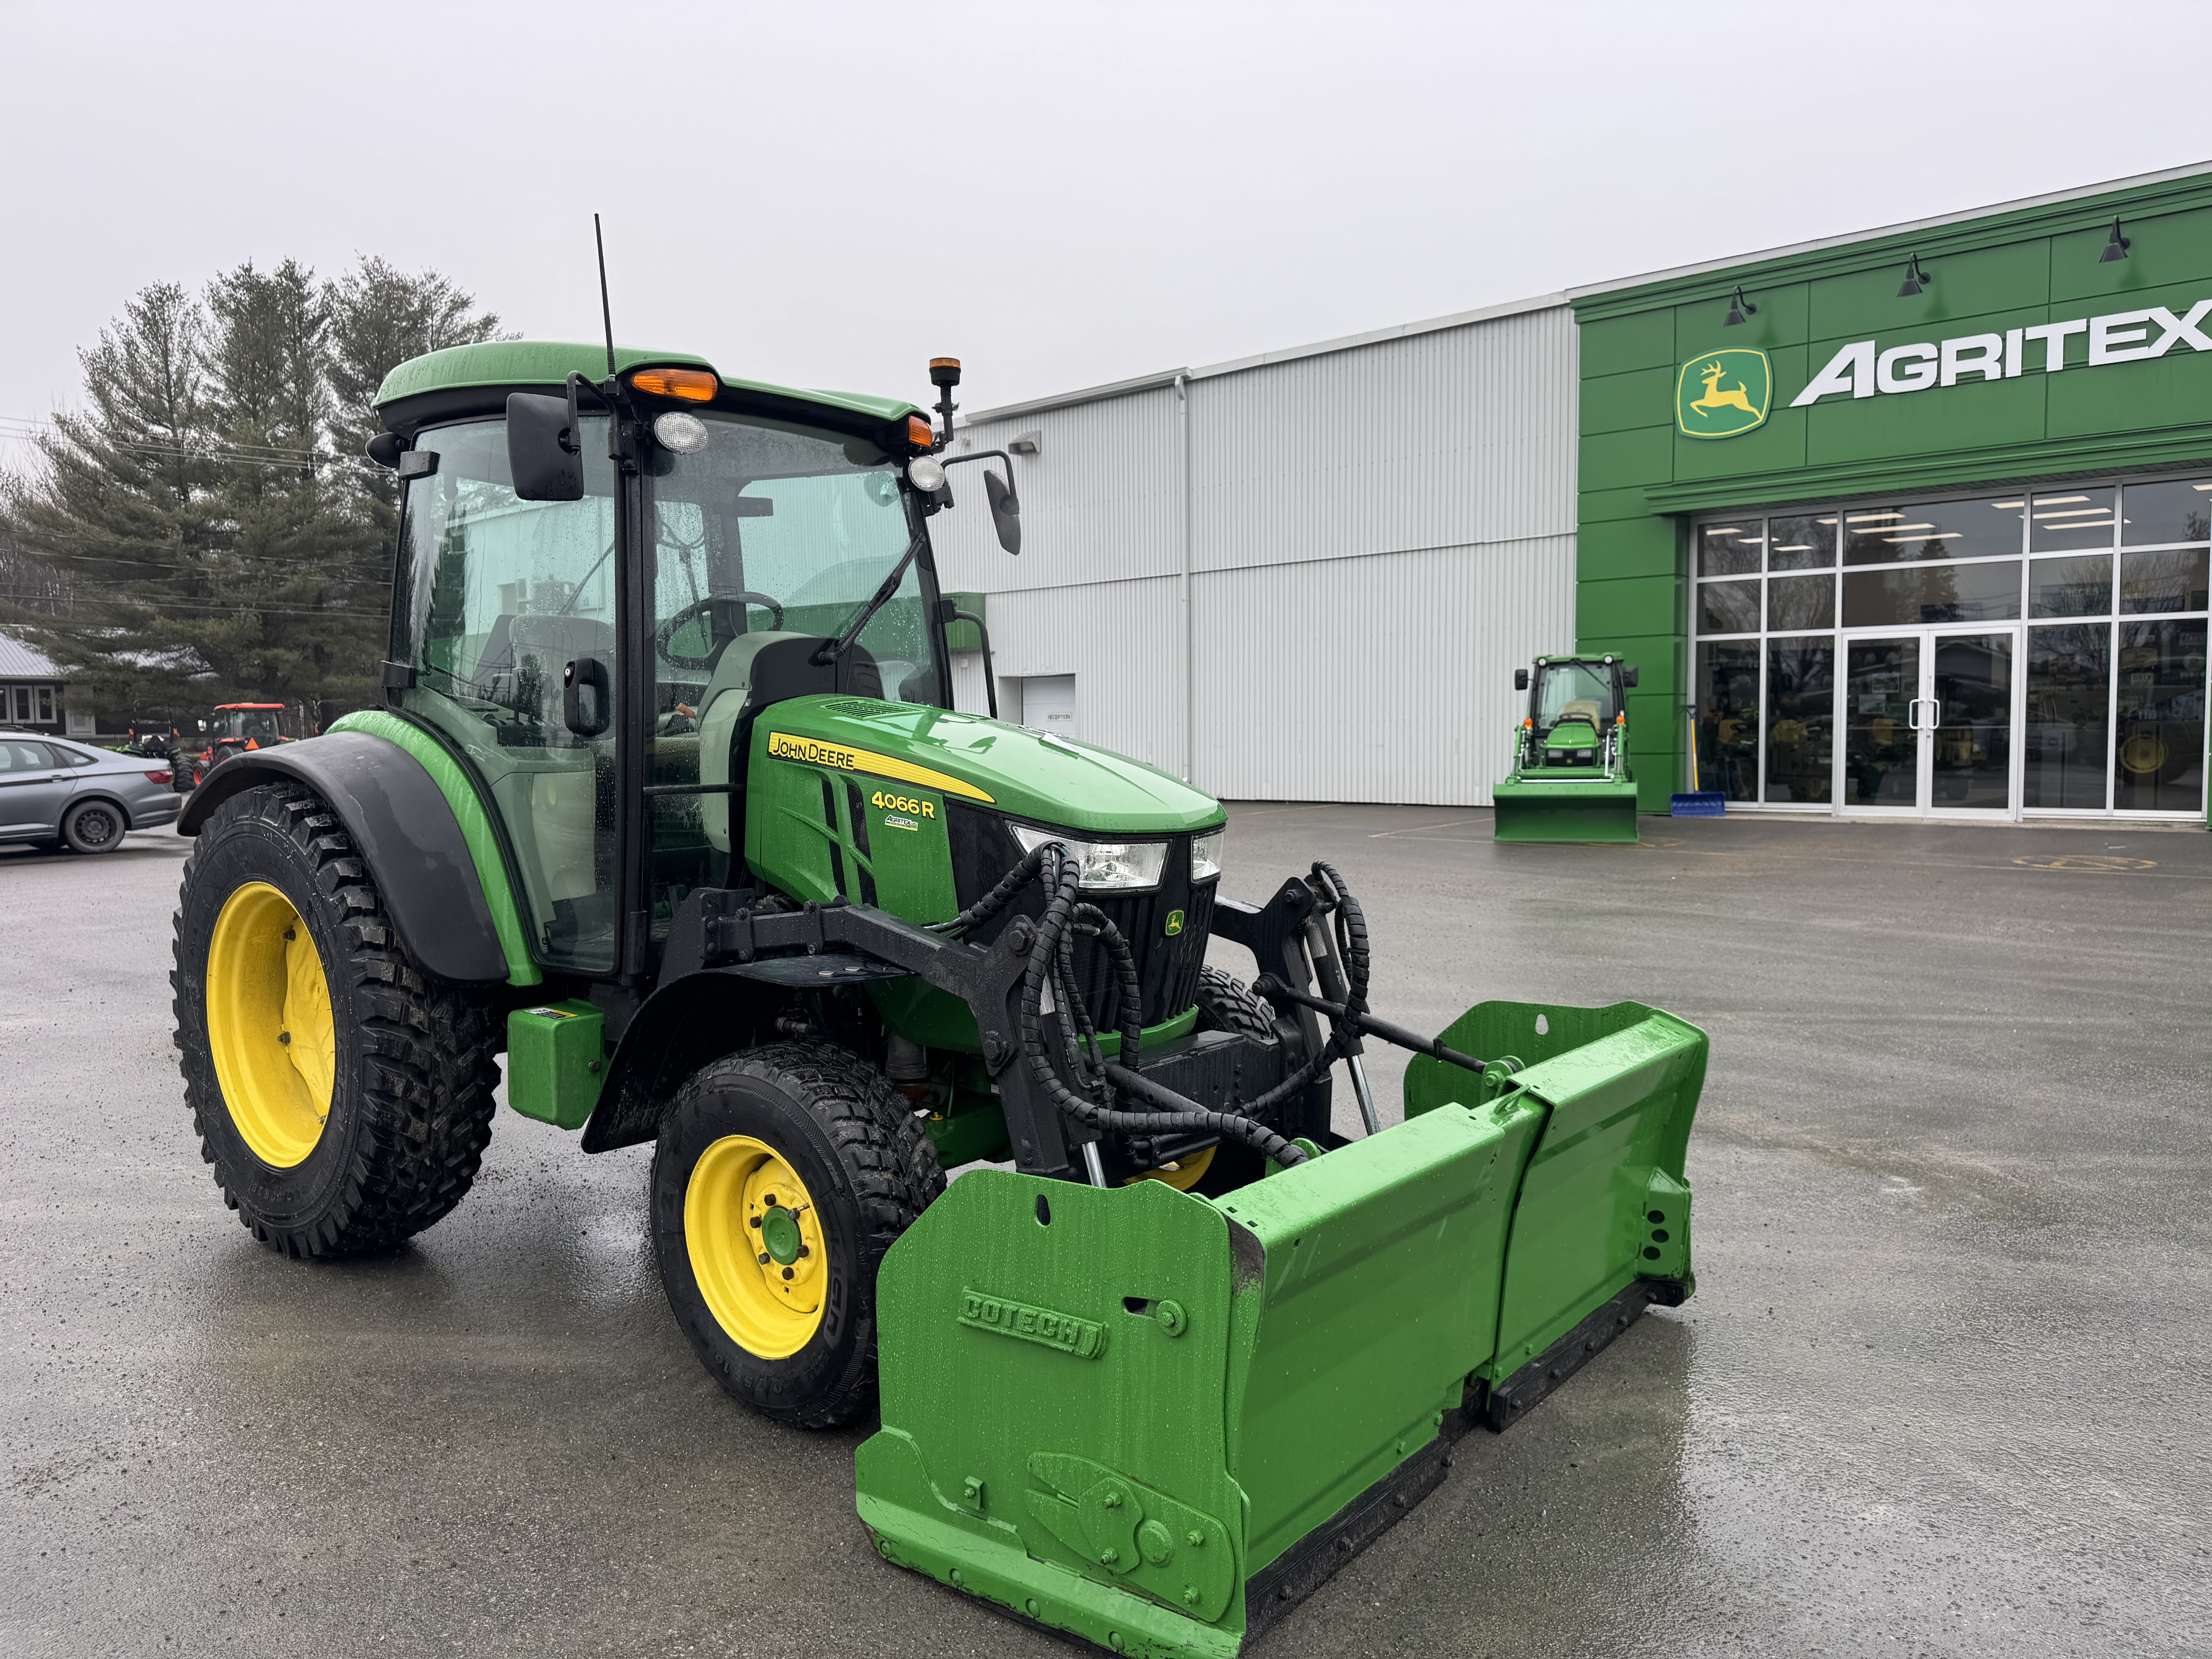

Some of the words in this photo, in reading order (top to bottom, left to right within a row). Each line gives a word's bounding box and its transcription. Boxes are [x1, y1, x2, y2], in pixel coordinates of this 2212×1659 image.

[1789, 298, 2212, 408] AGRITEX
[773, 738, 806, 759] JOHN
[809, 744, 854, 768] DEERE
[887, 816, 911, 825] AGRITEX
[963, 1295, 1080, 1344] COTECH
